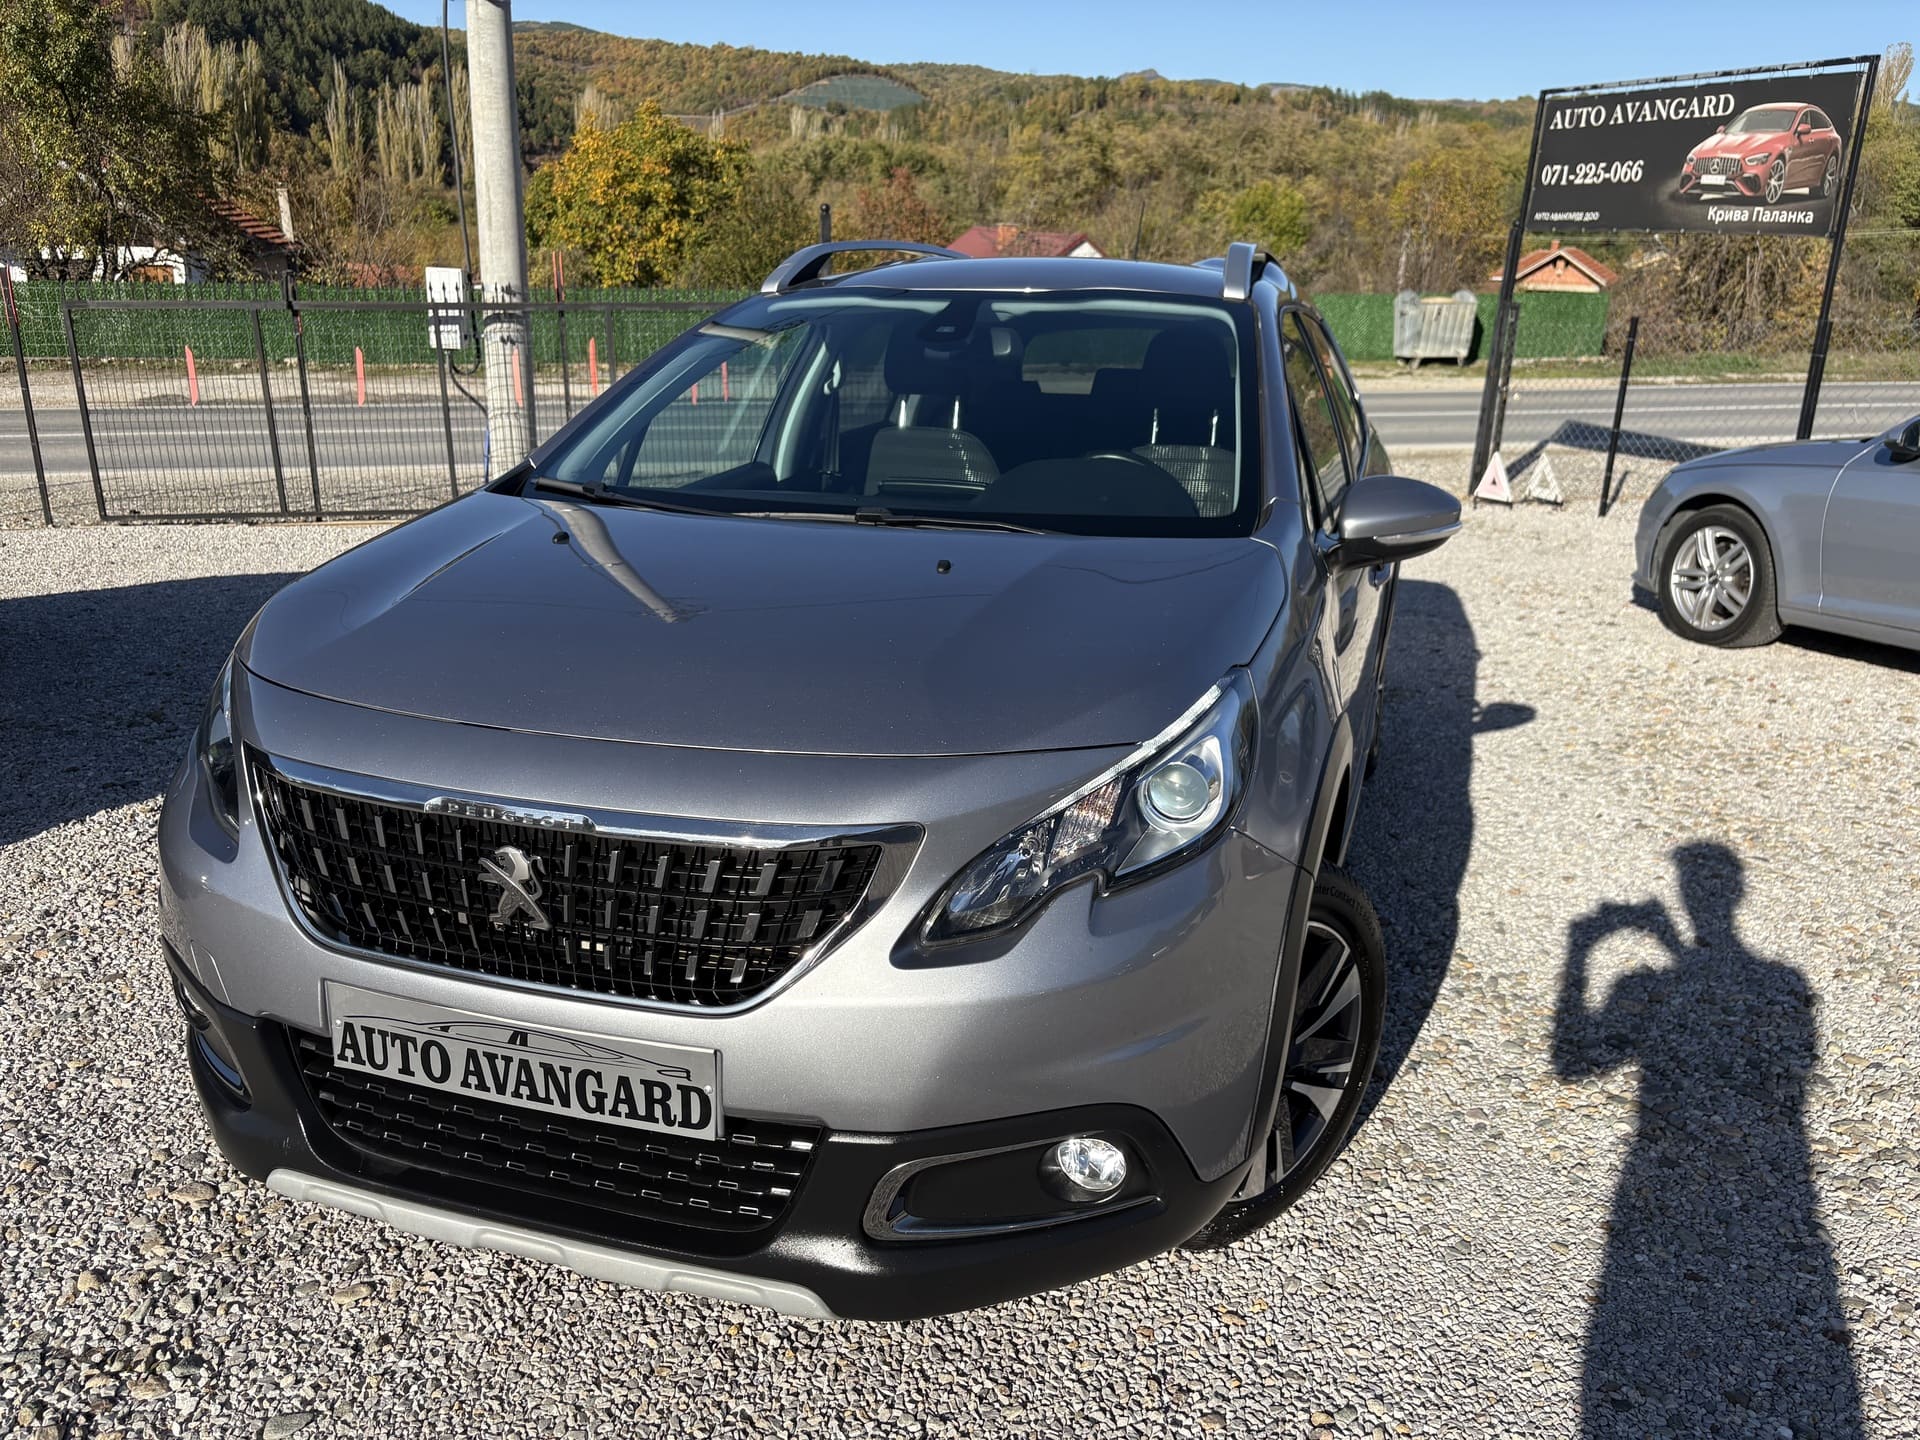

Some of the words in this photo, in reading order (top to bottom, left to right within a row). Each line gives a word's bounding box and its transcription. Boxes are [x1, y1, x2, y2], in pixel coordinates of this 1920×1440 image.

[1549, 105, 1606, 131] AUTO
[1609, 93, 1735, 126] AVANGARD
[1541, 159, 1644, 186] 071-225-066
[1707, 205, 1749, 224] Крива
[1752, 206, 1814, 224] Паланка
[447, 802, 575, 829] PEUGEOT
[337, 1021, 451, 1084] AUTO
[460, 1048, 712, 1131] AVANGARD
